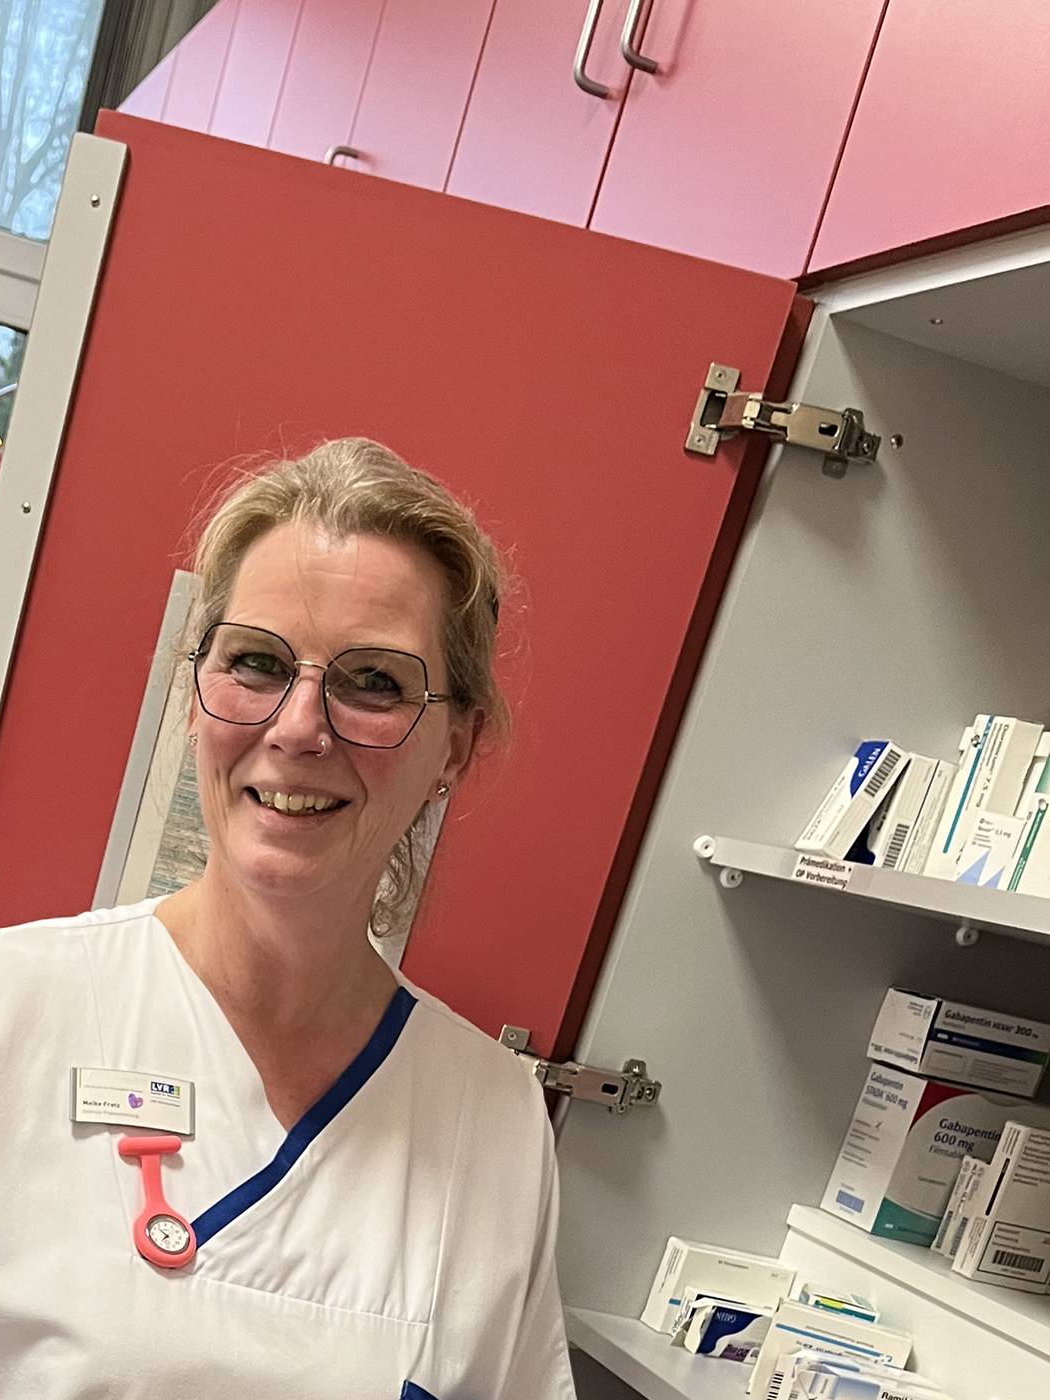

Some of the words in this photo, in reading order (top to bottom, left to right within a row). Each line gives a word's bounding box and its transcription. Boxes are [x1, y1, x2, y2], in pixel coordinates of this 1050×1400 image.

[806, 871, 848, 890] Vorbereitung
[945, 1009, 992, 1029] Gabapentin
[1015, 1024, 1033, 1037] 300
[939, 1118, 1001, 1142] Gabapentin
[934, 1131, 957, 1145] 600
[958, 1139, 975, 1153] mg
